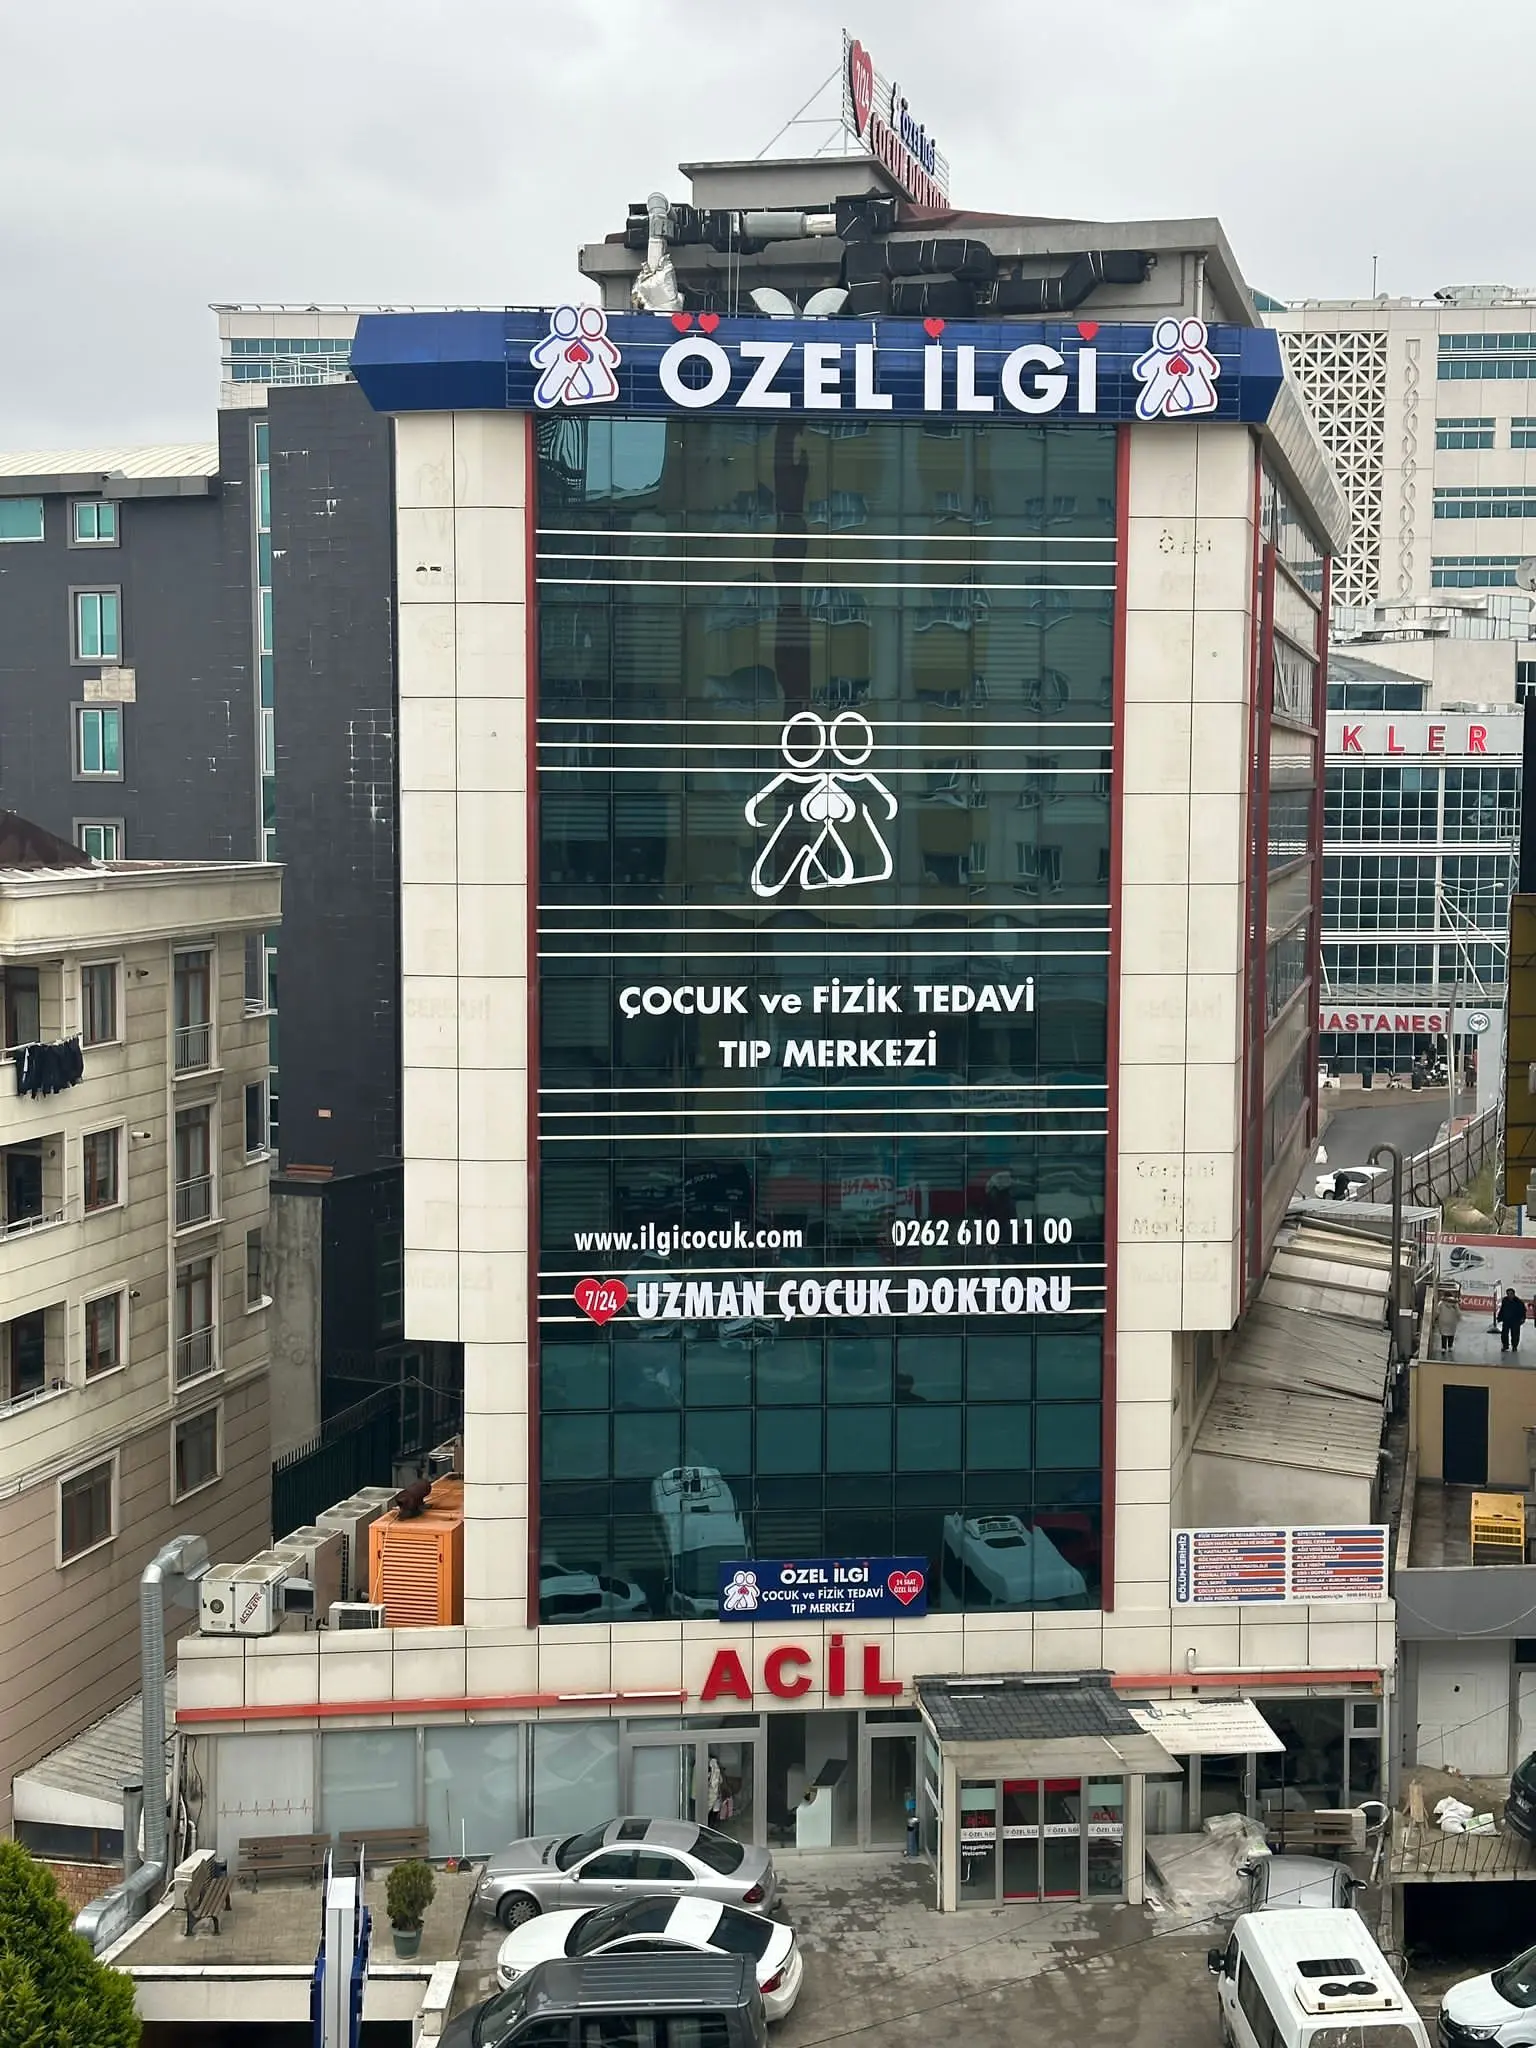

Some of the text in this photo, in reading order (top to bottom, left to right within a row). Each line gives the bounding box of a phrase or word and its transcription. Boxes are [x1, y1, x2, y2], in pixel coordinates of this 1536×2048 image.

[659, 312, 1097, 415] ÖZEL İLGİ
[1342, 724, 1488, 753] KLER
[618, 976, 1035, 1018] ÇOCUK ve FİZİK TEDAVİ
[718, 1030, 938, 1068] TIP MERKEZİ
[574, 1221, 803, 1256] www.ilgicocuk.com
[891, 1217, 1072, 1247] 0262 610 11 00
[585, 1290, 618, 1311] 7/24
[637, 1276, 1072, 1321] UZMAN ÇOCUK DOKTORU
[780, 1562, 869, 1584] ÖZEL İLGİ
[762, 1585, 883, 1603] ÇOCUK ve FİZİK TEDAVİ
[791, 1600, 855, 1614] TIP MERKEZİ
[700, 1632, 903, 1702] ACİL
